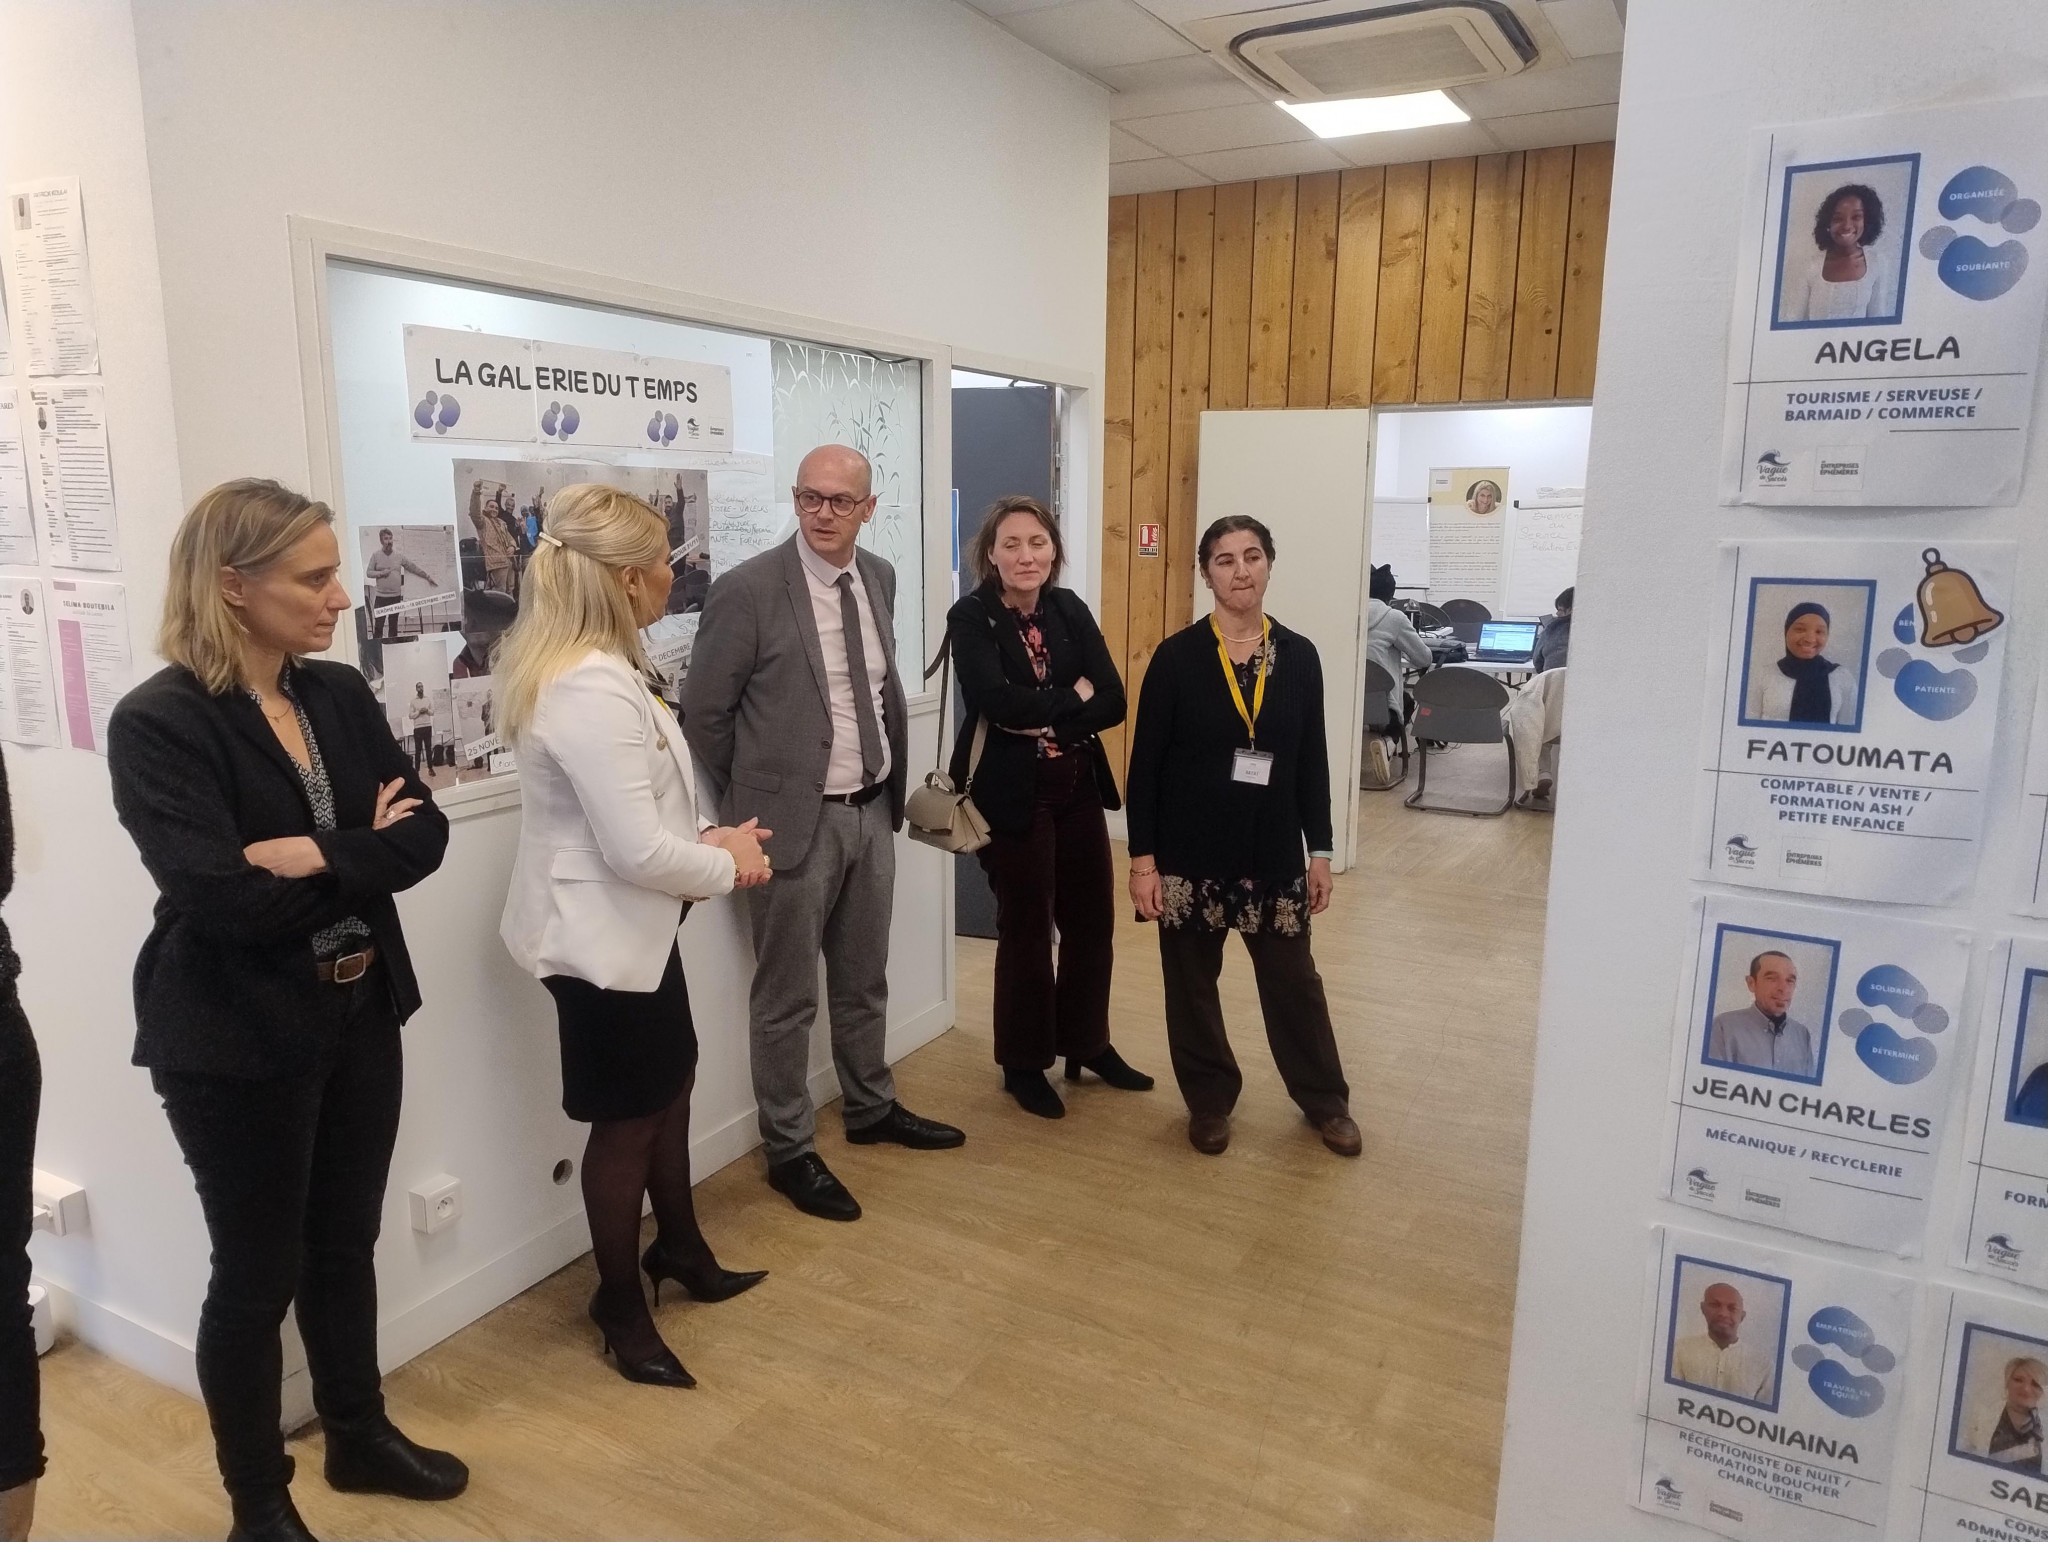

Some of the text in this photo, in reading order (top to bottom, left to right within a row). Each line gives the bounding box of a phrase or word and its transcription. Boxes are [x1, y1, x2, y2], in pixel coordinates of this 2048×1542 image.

[1814, 335, 1961, 364] ANGELA
[435, 358, 473, 385] LA
[592, 371, 621, 396] DU
[1786, 387, 1984, 405] TOURISME / SERVEUSE /
[1784, 405, 1976, 422] BARMAID / COMMERCE
[1756, 465, 1788, 476] Vague
[658, 643, 692, 662] DECEMBRE
[1914, 685, 1956, 694] PATIENTE
[467, 746, 478, 756] 25
[1746, 739, 1953, 774] FATOUMATA
[1760, 778, 1932, 802] COMPTABLE / VENTE /
[1769, 794, 1914, 817] FORMATION ASH /
[1778, 810, 1905, 832] PETITE ENFANCE
[1870, 984, 1915, 996] SOLIDAIRE
[1692, 1076, 1932, 1139] JEAN CHARLES
[1705, 1127, 1903, 1178] MÉCANIQUE / RECYCLERIE
[1677, 1398, 1860, 1464] RADONIAINA
[1686, 1446, 1840, 1499] FORMATION BOUCHER
[1784, 1462, 1802, 1476] DE
[1806, 1468, 1842, 1486] NUIT
[1844, 1479, 1851, 1488] /
[1717, 1468, 1803, 1502] CHARCUTIER
